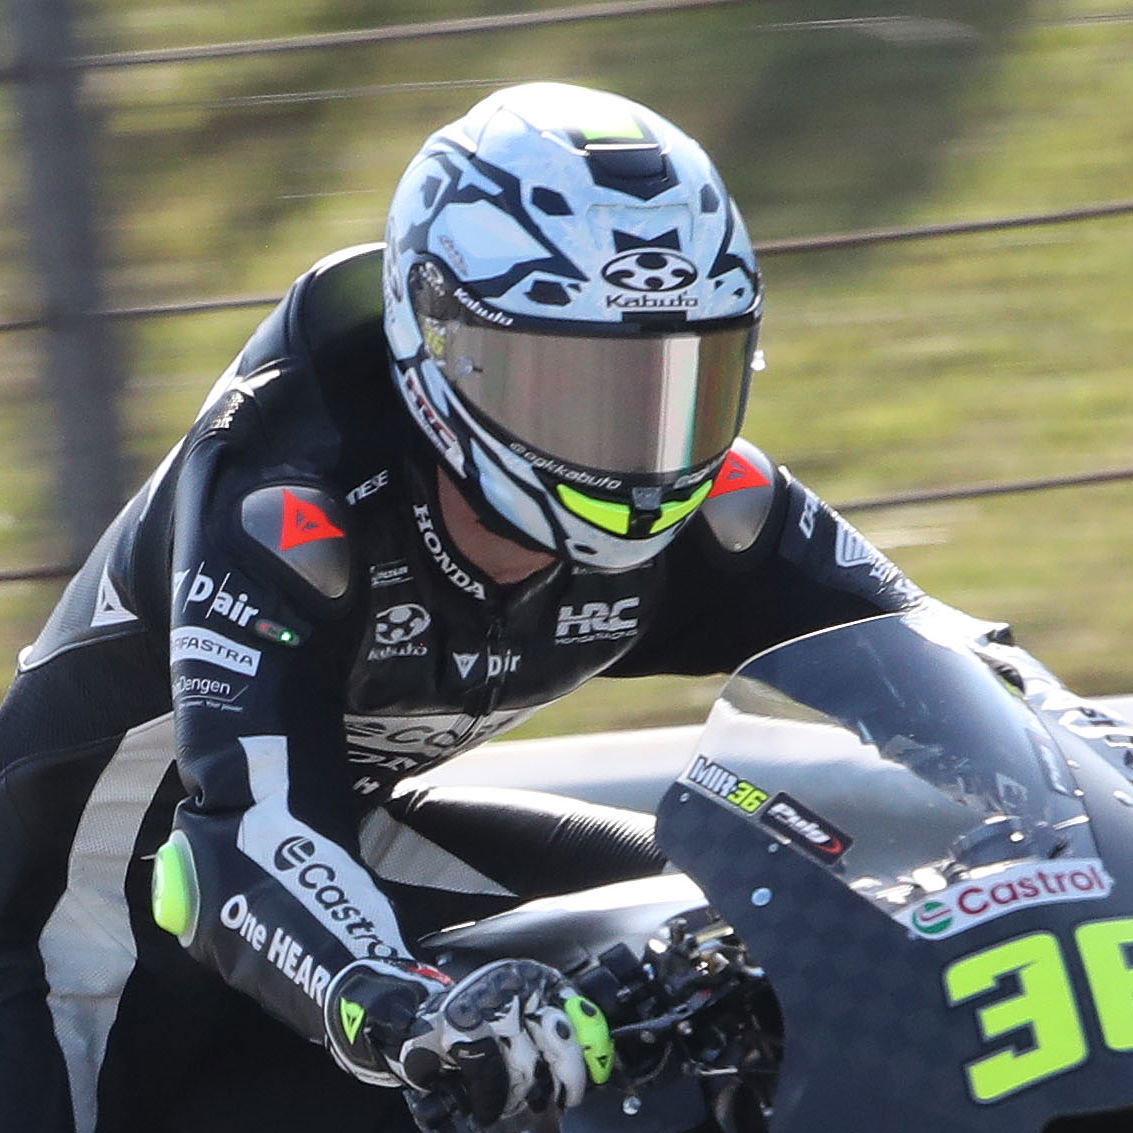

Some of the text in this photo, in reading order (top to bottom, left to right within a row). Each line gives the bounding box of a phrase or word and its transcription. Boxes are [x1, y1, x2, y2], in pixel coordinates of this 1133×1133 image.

[606, 291, 699, 308] Kabuto
[413, 504, 486, 600] HONDA
[555, 597, 640, 637] HRC
[298, 863, 398, 960] Castro
[958, 865, 1105, 918] Castrol
[220, 894, 331, 1008] One HEAR
